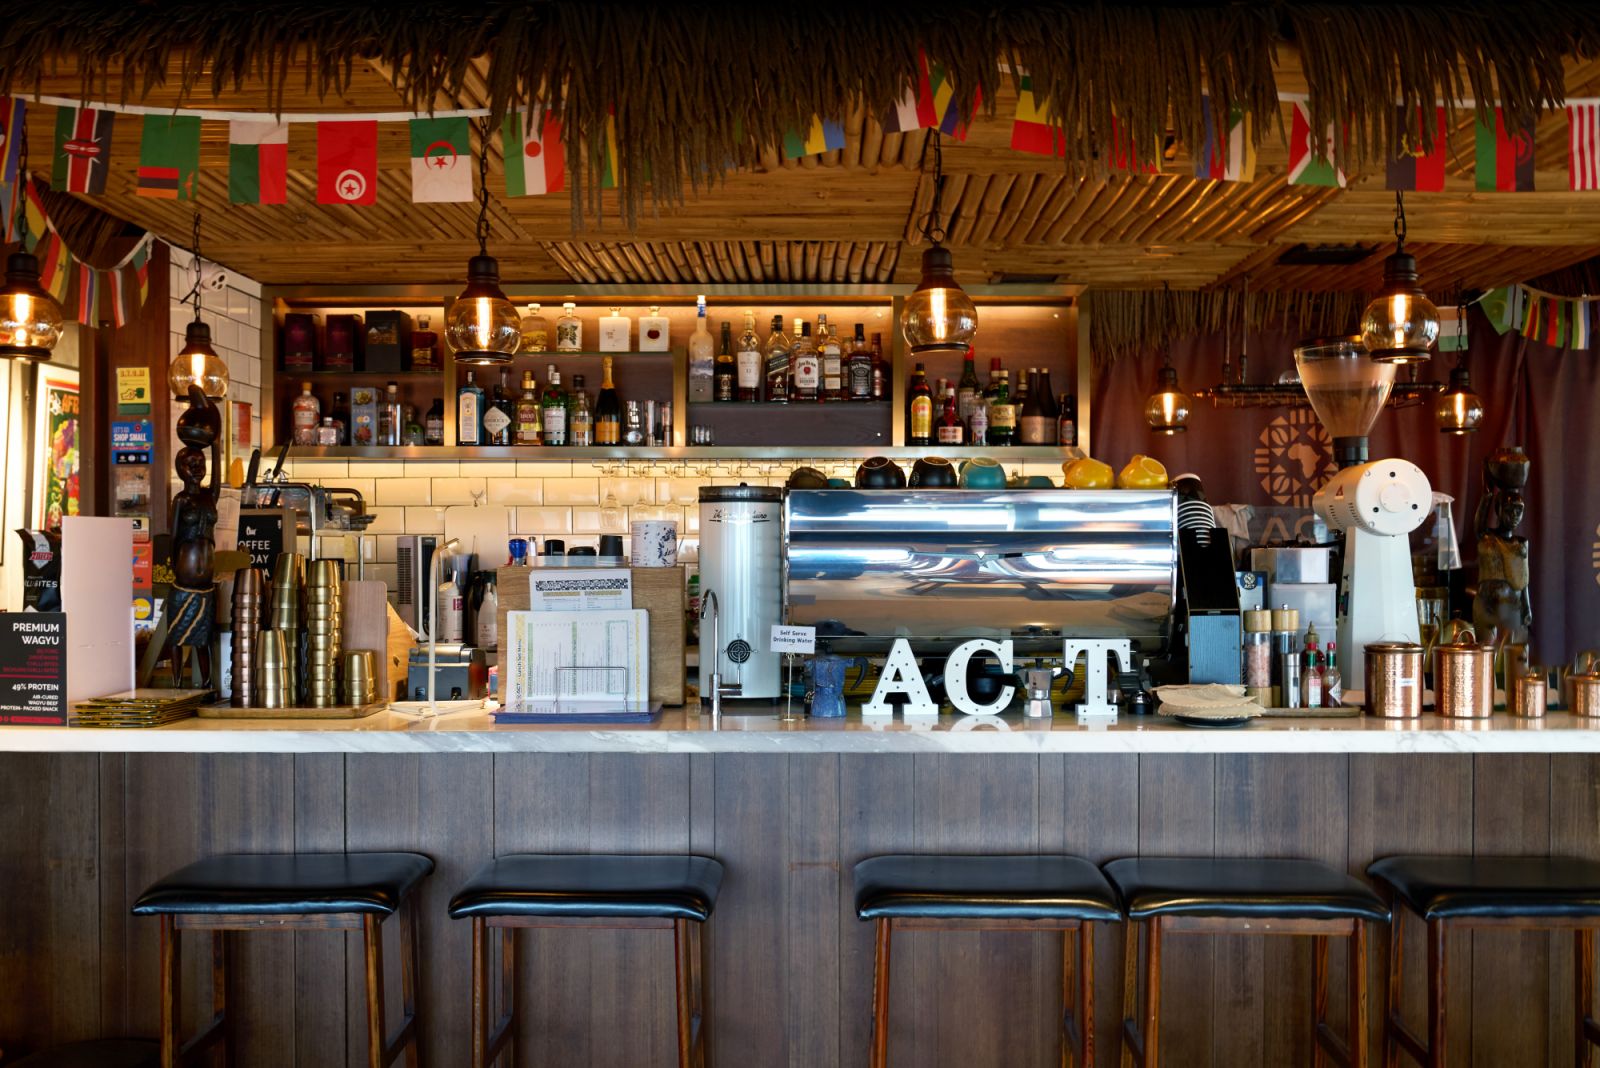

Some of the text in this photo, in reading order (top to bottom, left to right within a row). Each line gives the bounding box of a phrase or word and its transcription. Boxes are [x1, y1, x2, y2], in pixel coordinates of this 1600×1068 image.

[114, 433, 147, 441] SHOP SMALL
[13, 622, 60, 632] PREMIUM
[21, 635, 60, 645] WAGYU
[861, 638, 1131, 716] ACT
[12, 683, 59, 691] 49% PROTEIN
